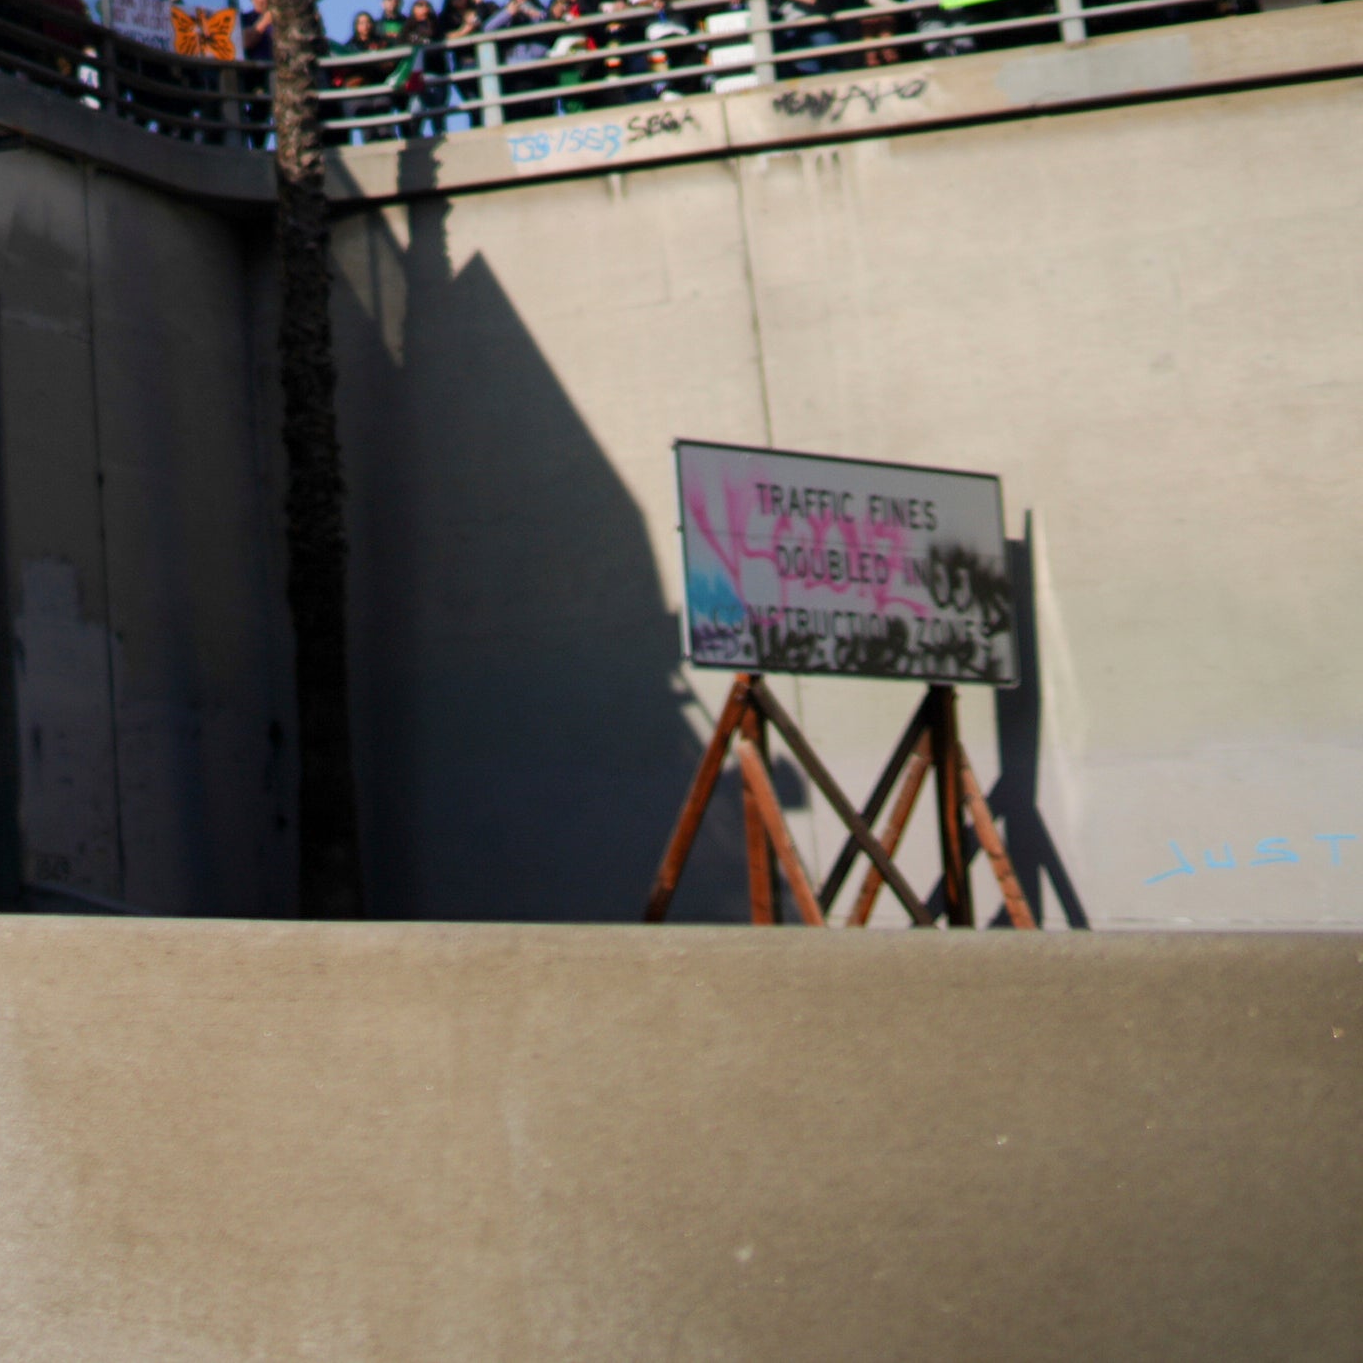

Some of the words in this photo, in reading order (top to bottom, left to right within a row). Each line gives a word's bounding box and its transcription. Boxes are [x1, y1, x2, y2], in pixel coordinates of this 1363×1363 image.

[755, 482, 856, 524] TRAFFIC
[868, 494, 939, 532] FINES
[776, 544, 890, 586] DOUBLED
[1143, 833, 1358, 886] JUST
